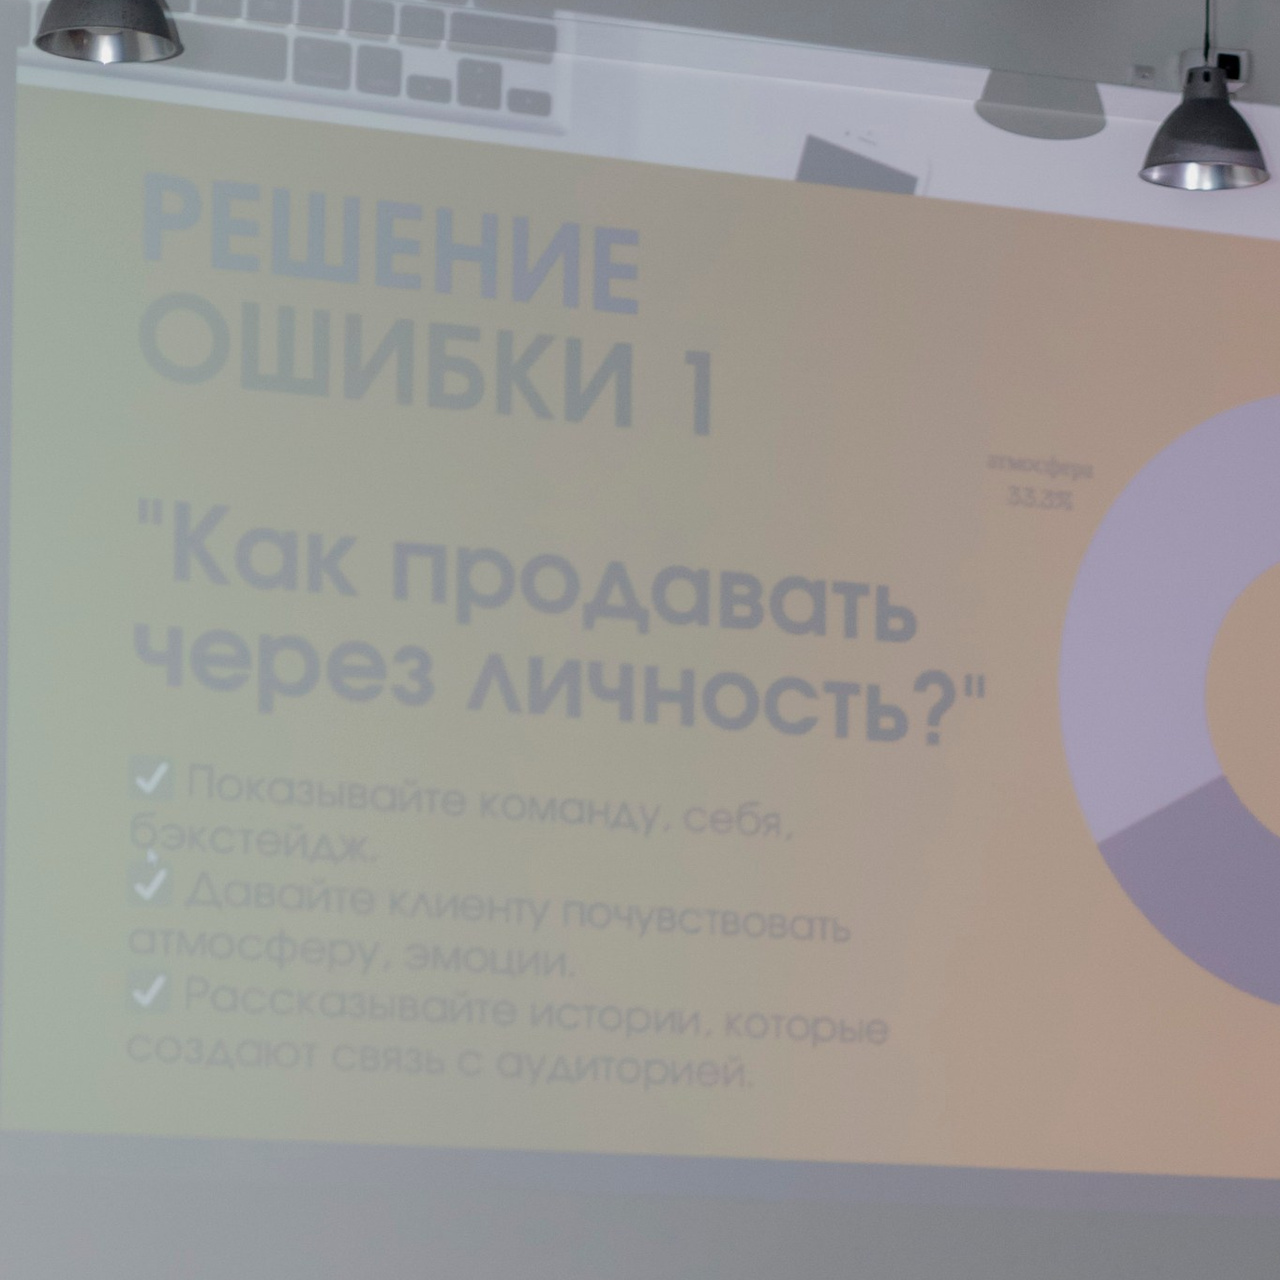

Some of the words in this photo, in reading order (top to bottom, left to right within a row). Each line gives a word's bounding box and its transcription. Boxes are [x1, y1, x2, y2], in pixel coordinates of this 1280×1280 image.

[143, 173, 639, 315] РЕШЕНИЕ
[138, 291, 633, 428] ОШИБКИ
[684, 350, 711, 436] 1
[137, 497, 360, 597] "Как
[393, 541, 918, 643] продавать
[133, 622, 435, 714] через
[466, 652, 986, 746] личность?"
[129, 811, 379, 865] бэкстейдж.
[187, 763, 467, 816] Показывайте
[684, 801, 794, 841] себя,
[184, 871, 376, 915] Давайте
[389, 891, 551, 932] клиенту
[562, 899, 852, 944] почувствовать
[127, 927, 392, 975] атмосферу,
[404, 941, 576, 979] эмоции.
[185, 975, 518, 1027] Рассказывайте
[725, 1011, 891, 1049] которые
[126, 1033, 319, 1071] создают
[331, 1041, 446, 1076] связь
[457, 1049, 484, 1076] с
[496, 1050, 755, 1092] аудиторией.
